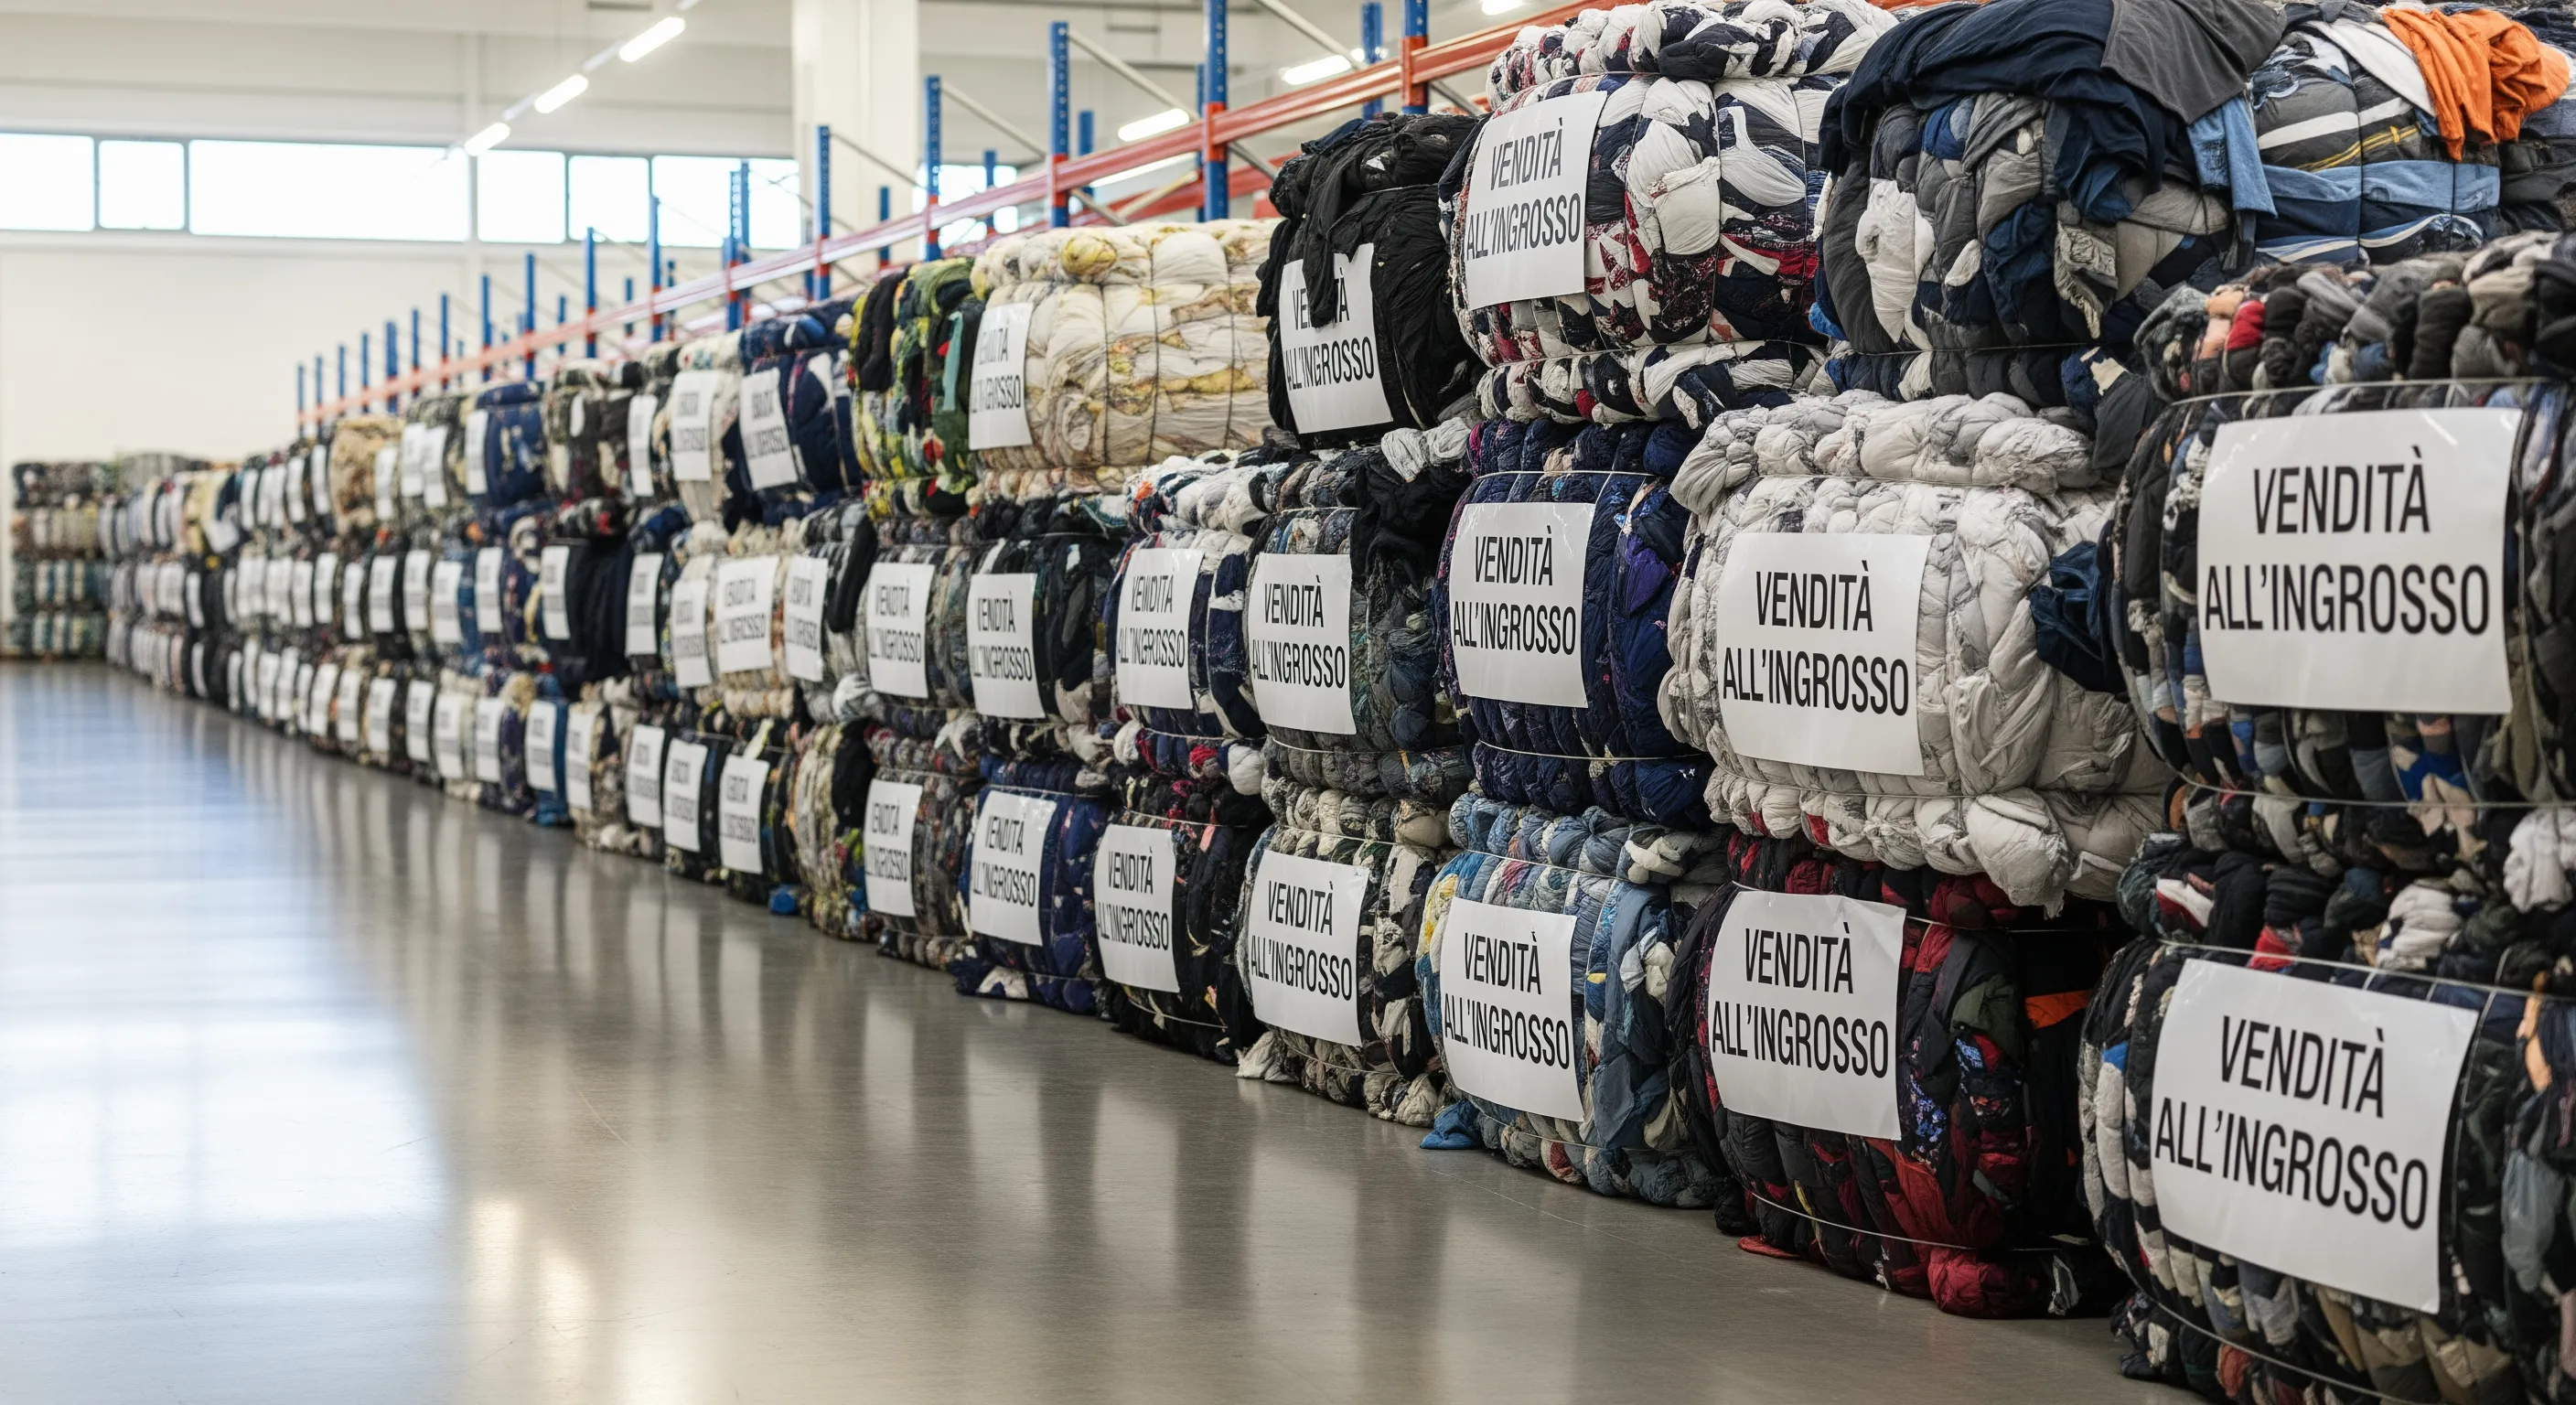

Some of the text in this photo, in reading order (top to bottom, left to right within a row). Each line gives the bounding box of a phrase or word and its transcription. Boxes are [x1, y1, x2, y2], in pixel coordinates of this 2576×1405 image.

[1490, 116, 1563, 191] VENDITÀ
[1466, 192, 1581, 261] ALL'INGROSSO
[1292, 266, 1350, 331] VETÀ
[1284, 336, 1375, 391] ALL'INGROSSO
[2254, 445, 2431, 535] VENDITÀ
[1475, 524, 1553, 586] VENDITÀ
[1264, 574, 1325, 627] VENDITÀ
[1454, 601, 1577, 656] ALL'INGROSSO
[1755, 559, 1873, 632] VENDITÀ
[2205, 563, 2489, 636] ALL'INGROSSO
[1252, 638, 1346, 689] ALL'INGROSSO
[1723, 647, 1909, 716] ALL'INGROSSO
[1108, 846, 1154, 895] VENDITÀ
[1268, 880, 1334, 937] VENDITÀ
[1250, 935, 1352, 1002] ALL'INGROSSO
[1465, 931, 1541, 995] VENDITÀ
[1744, 921, 1854, 994] VENDITÀ
[1444, 992, 1570, 1070] ALL'INGROSSO
[1712, 1001, 1889, 1078] ALL'INGROSSO
[2221, 1014, 2386, 1119] VENDITÀ
[2154, 1097, 2429, 1230] ALL'INGROSSO
